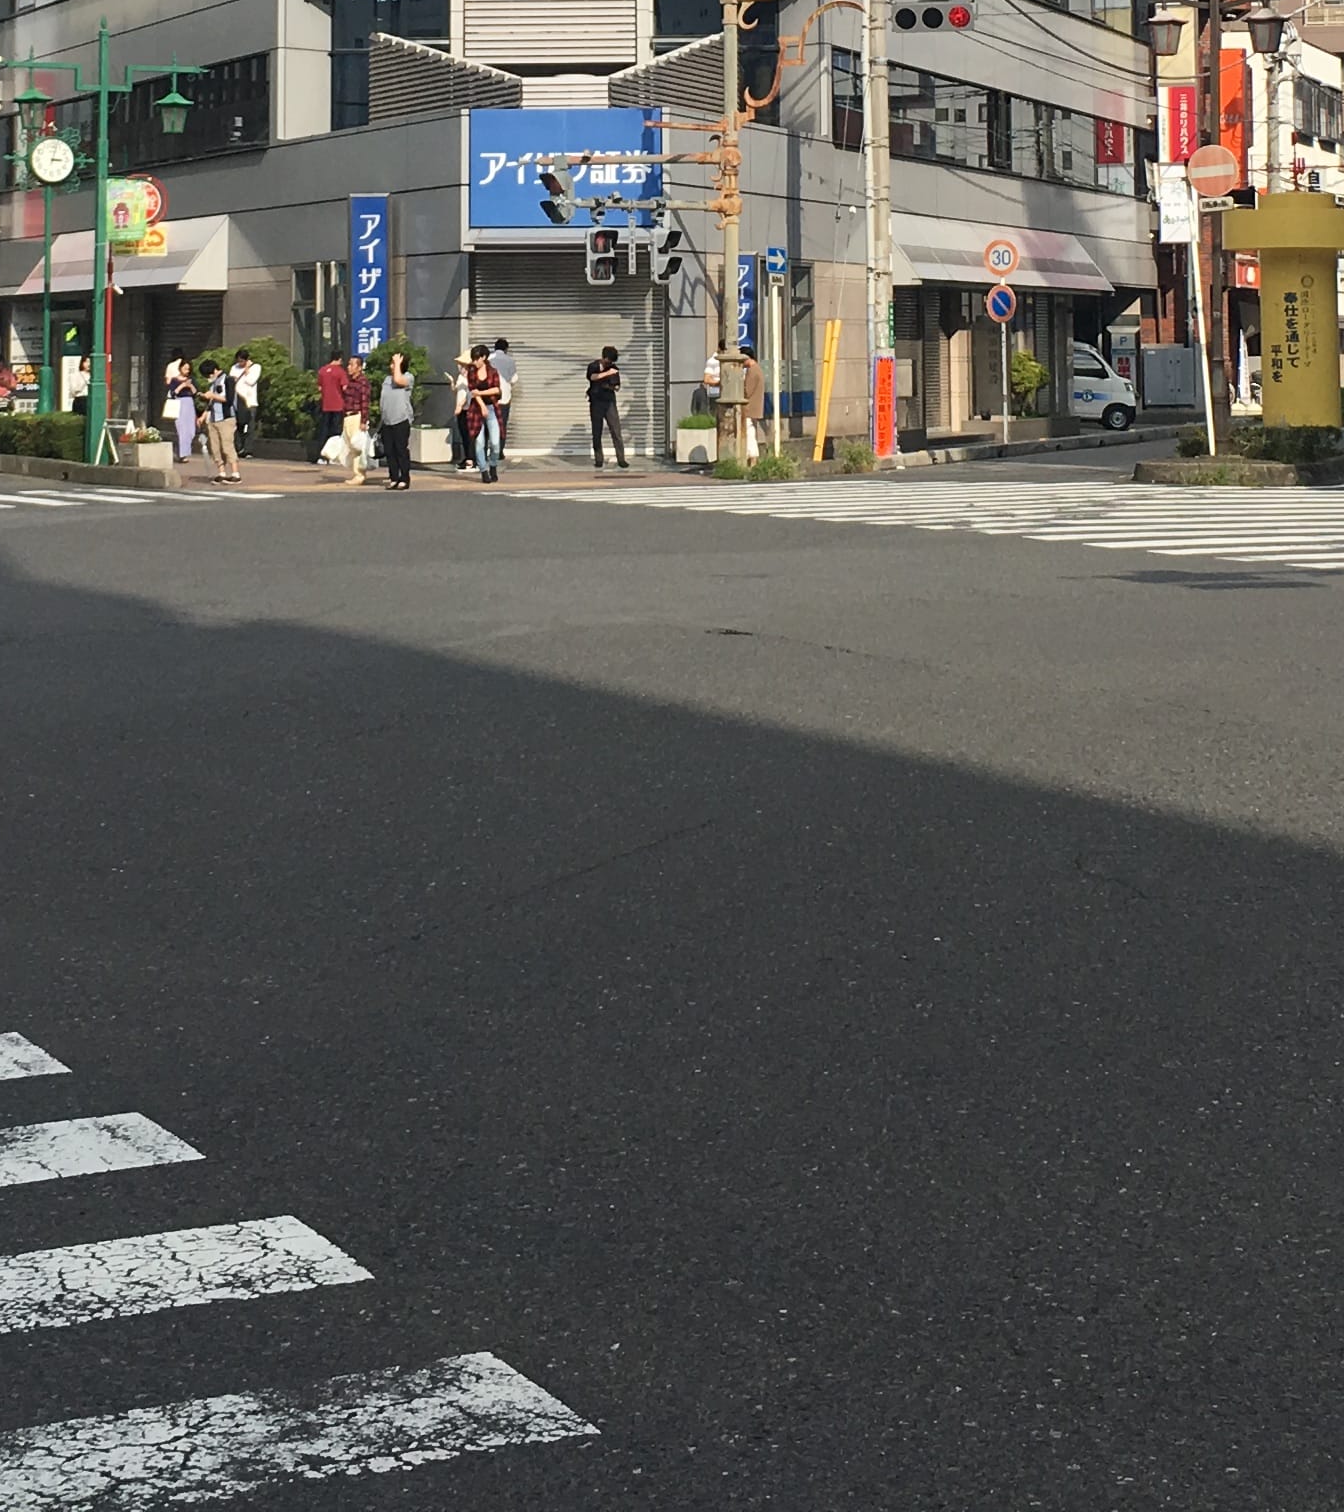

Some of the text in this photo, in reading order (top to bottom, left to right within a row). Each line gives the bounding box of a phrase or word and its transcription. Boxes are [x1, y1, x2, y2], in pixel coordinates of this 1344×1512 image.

[991, 249, 1011, 266] 30
[1284, 292, 1301, 369] 奉仕を通じて
[1270, 344, 1283, 384] 平和を
